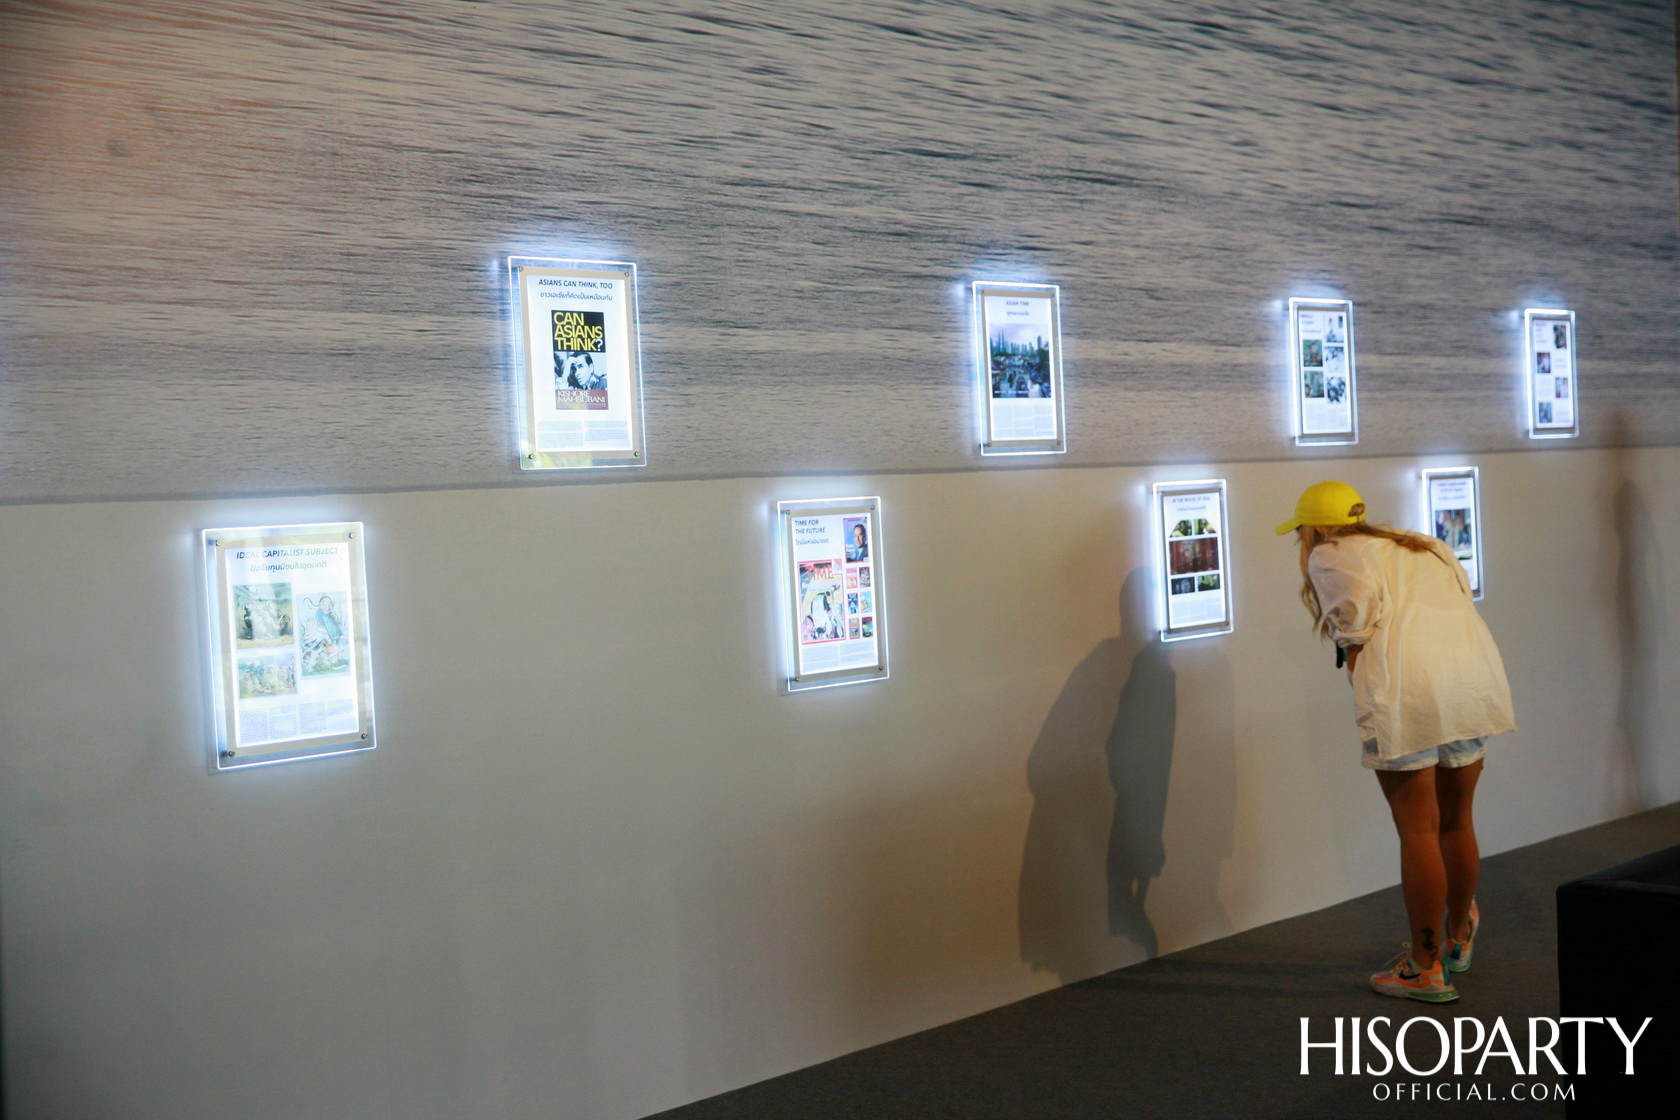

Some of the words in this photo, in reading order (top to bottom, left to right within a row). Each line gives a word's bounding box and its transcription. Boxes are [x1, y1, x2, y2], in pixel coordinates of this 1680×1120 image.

[578, 281, 598, 289] THINK,
[553, 311, 585, 326] CAN
[553, 324, 603, 339] ASIANS
[554, 337, 603, 352] THINK?
[236, 551, 260, 559] IDEAL
[262, 549, 304, 558] CAPITALIST
[305, 547, 339, 556] SUBJECT
[804, 564, 834, 581] TIME
